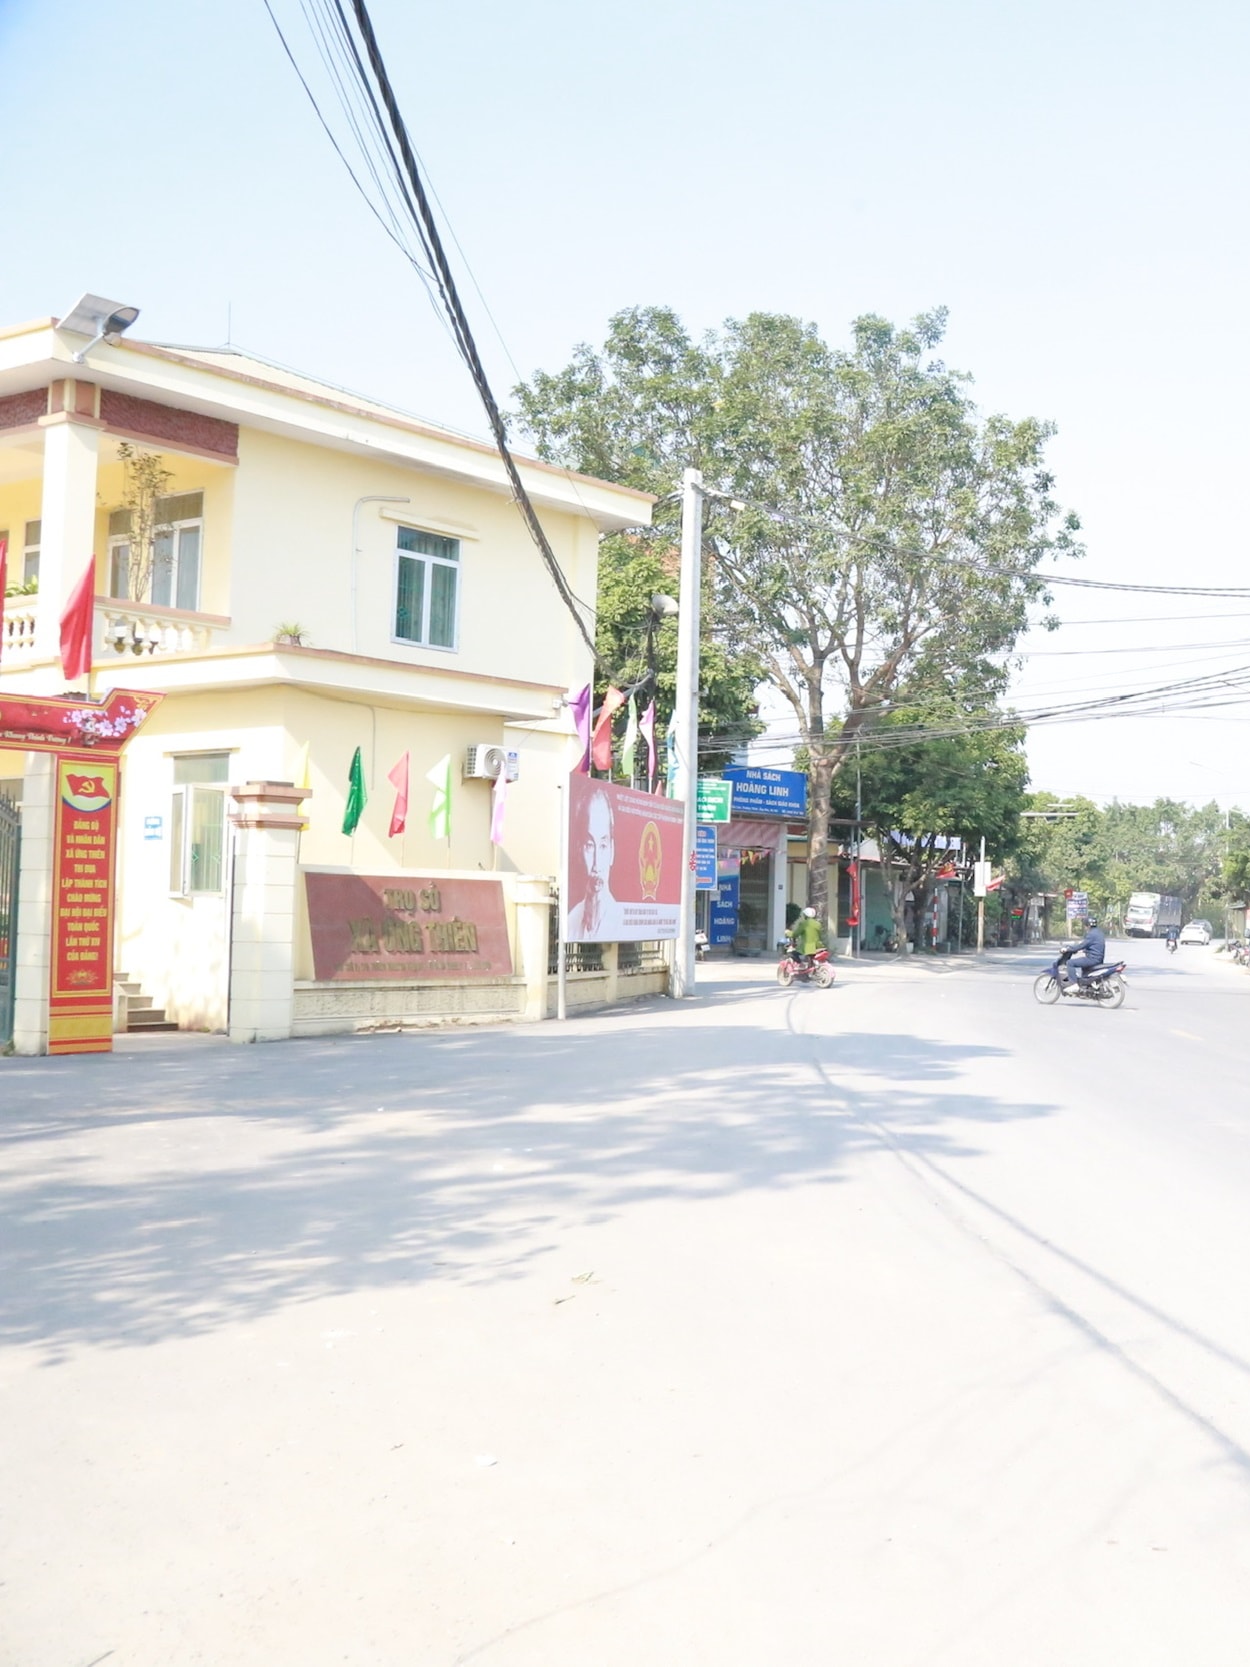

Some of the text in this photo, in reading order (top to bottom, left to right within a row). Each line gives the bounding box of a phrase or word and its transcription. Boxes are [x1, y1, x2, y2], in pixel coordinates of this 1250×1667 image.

[746, 769, 781, 782] NHÀ SÁCH
[736, 781, 767, 795] HOÀNG
[769, 785, 789, 797] LINH
[419, 881, 441, 912] SỞ
